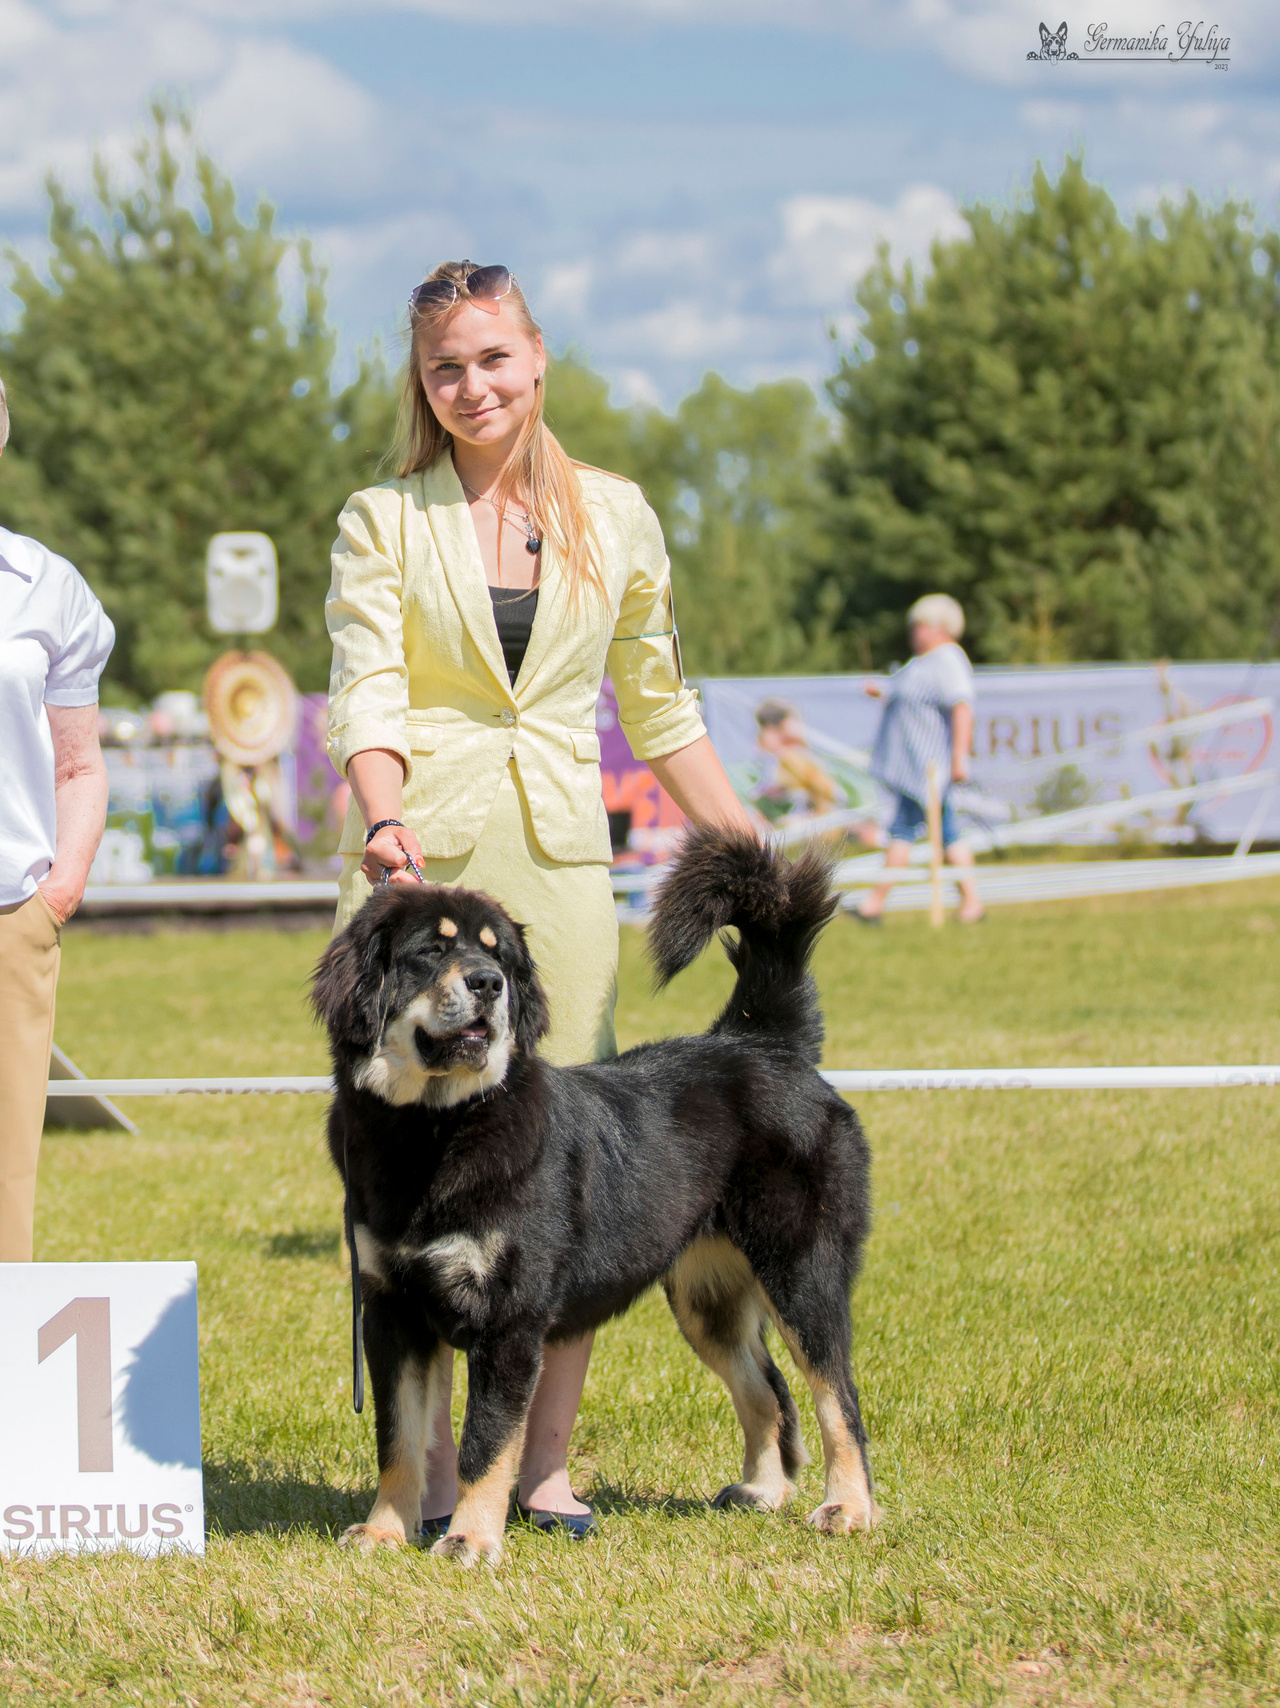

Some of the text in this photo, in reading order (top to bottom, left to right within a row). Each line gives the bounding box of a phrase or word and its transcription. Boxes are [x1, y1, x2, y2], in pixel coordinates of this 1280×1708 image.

[969, 712, 1122, 757] RIUS
[38, 1296, 113, 1473] 1
[3, 1503, 184, 1540] SIRIUS
